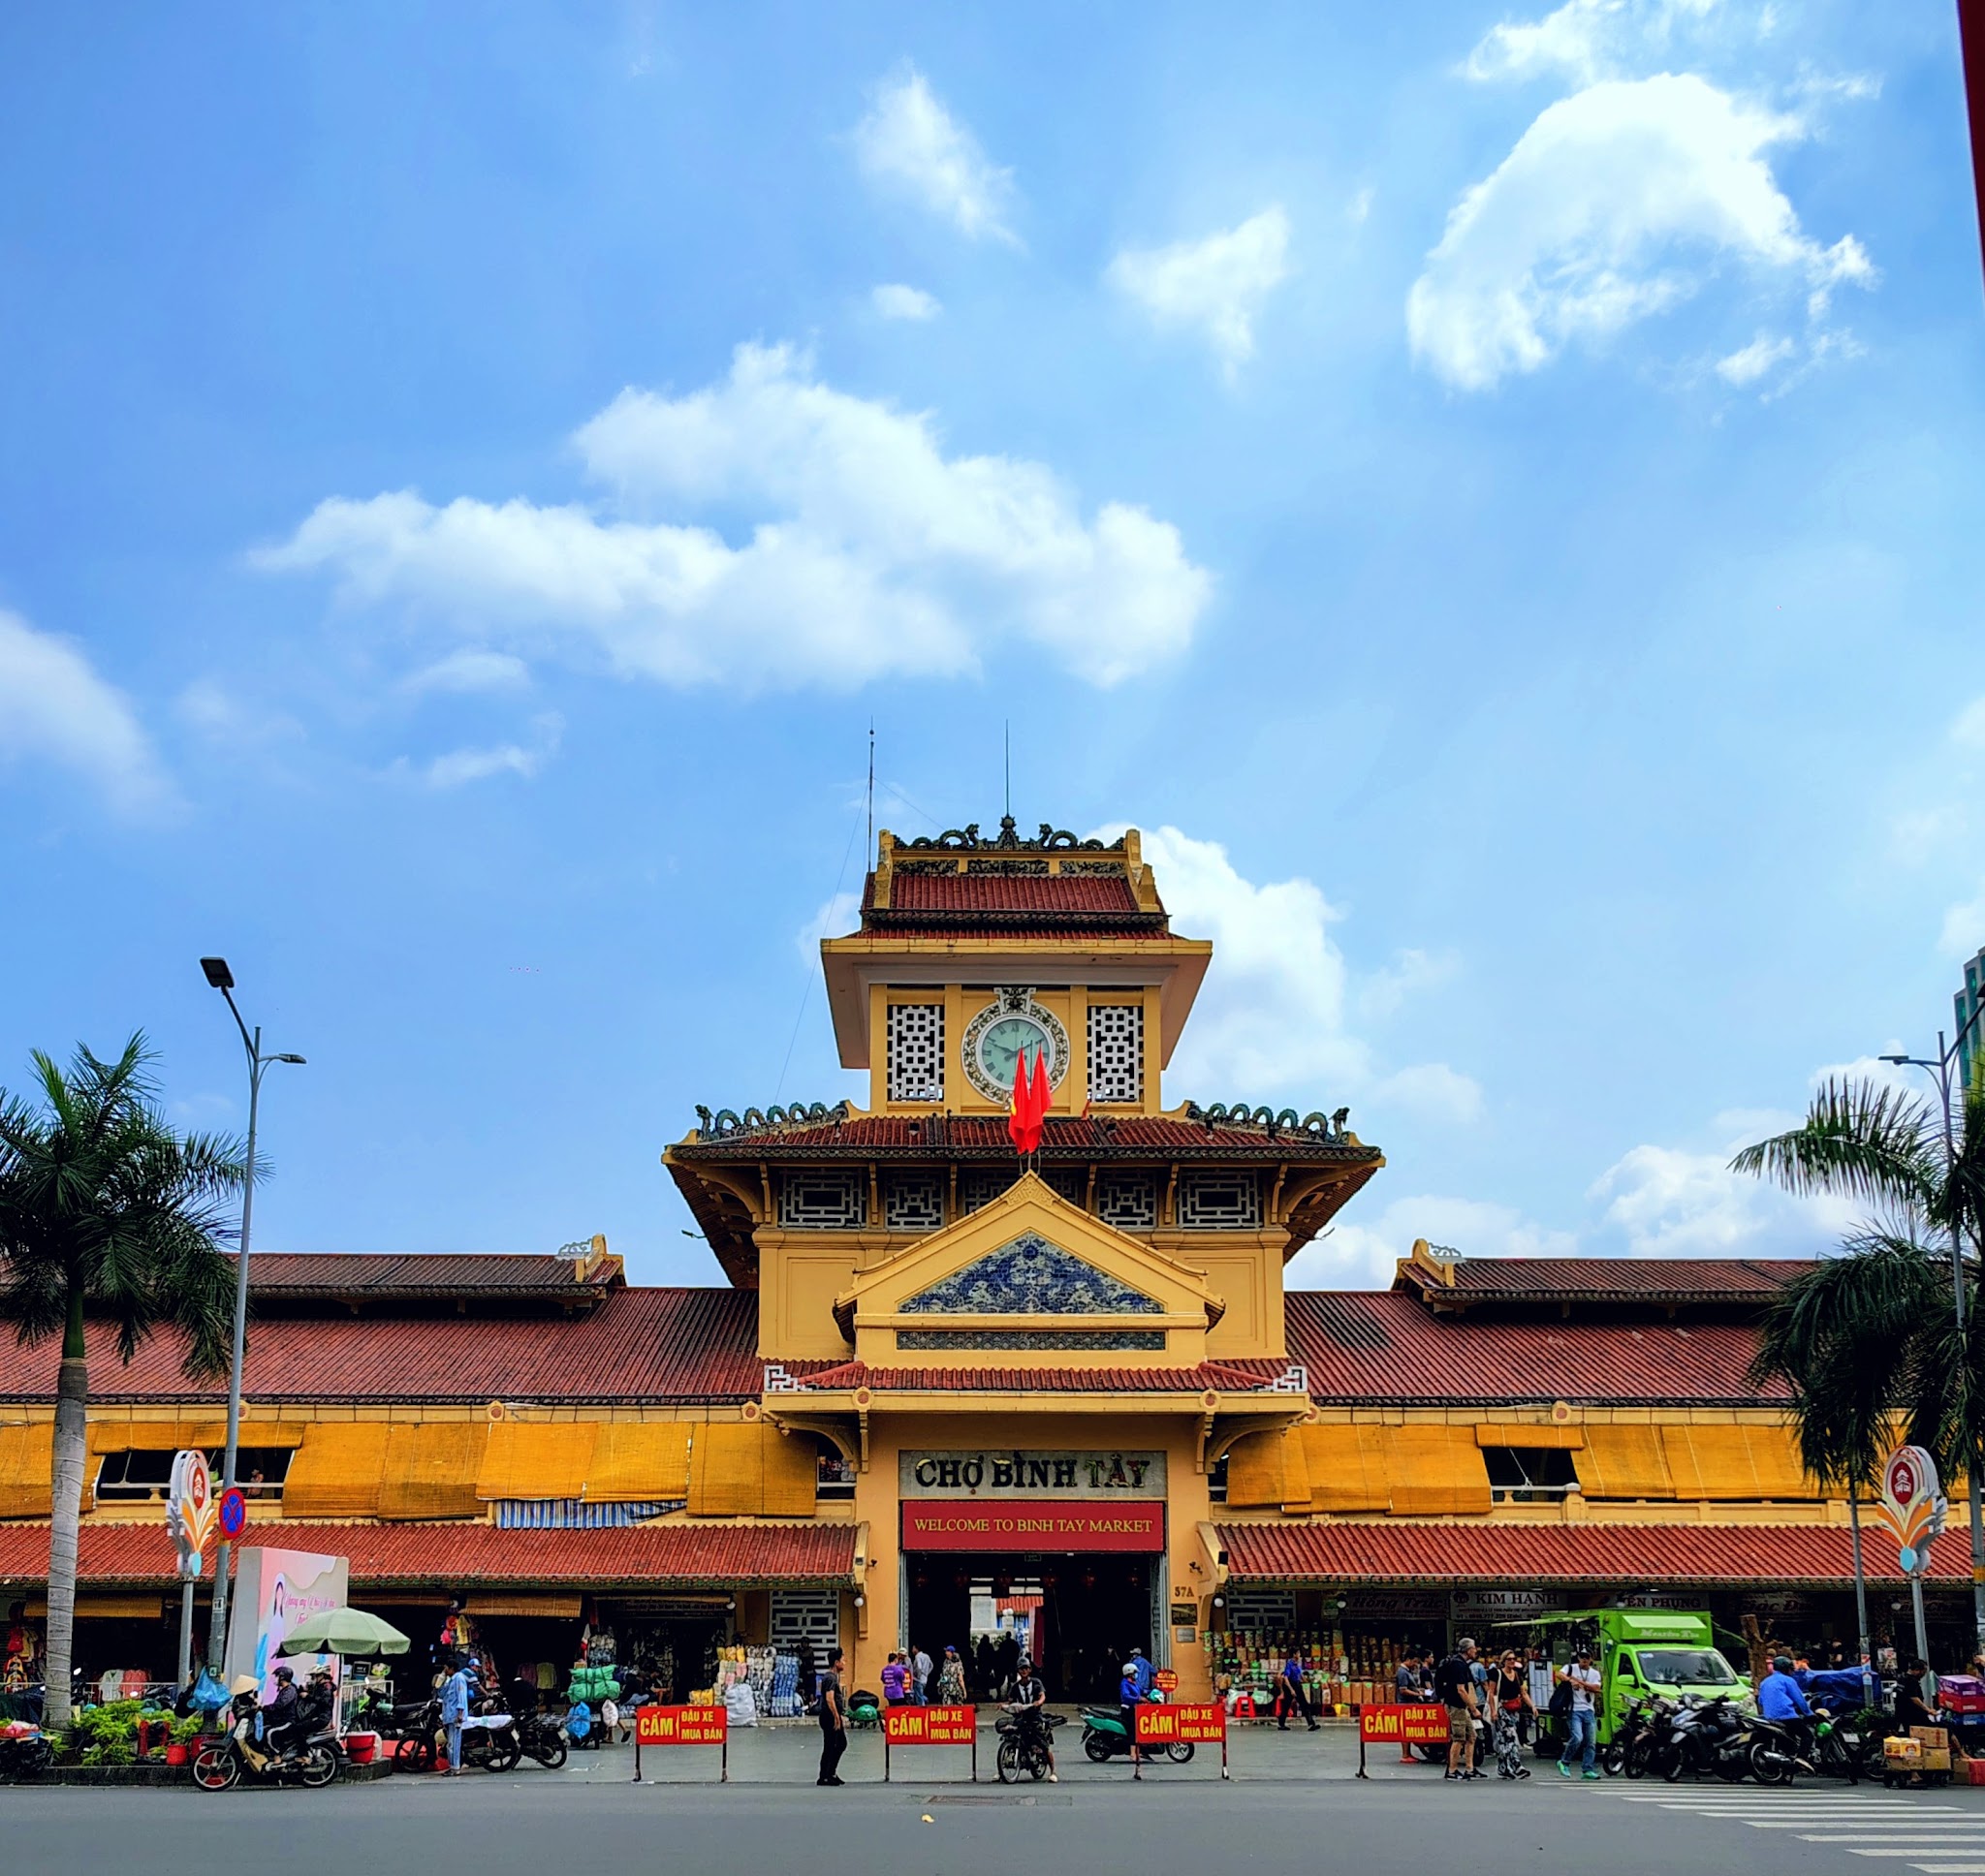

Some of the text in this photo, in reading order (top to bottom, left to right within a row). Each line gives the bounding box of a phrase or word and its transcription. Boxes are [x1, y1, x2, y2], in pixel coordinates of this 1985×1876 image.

[915, 1452, 1150, 1494] CHỢ BÌNH TÂY
[915, 1518, 1153, 1533] WELCOME TO BINH TAY MARKET
[1476, 1593, 1559, 1607] KIM HẠNH
[702, 1711, 714, 1722] XE
[951, 1710, 962, 1722] XE
[1201, 1708, 1213, 1720] XE
[1426, 1708, 1437, 1720] XE
[640, 1711, 674, 1736] CẤM
[889, 1711, 923, 1736] CẤM
[1139, 1709, 1173, 1735] CẤM
[1365, 1708, 1398, 1734] CẤM
[681, 1727, 723, 1740] MUA BÁN
[930, 1727, 972, 1740] MUA BÁN
[1181, 1725, 1222, 1738] MUA BÁN
[1405, 1725, 1447, 1738] MUA BÁN
